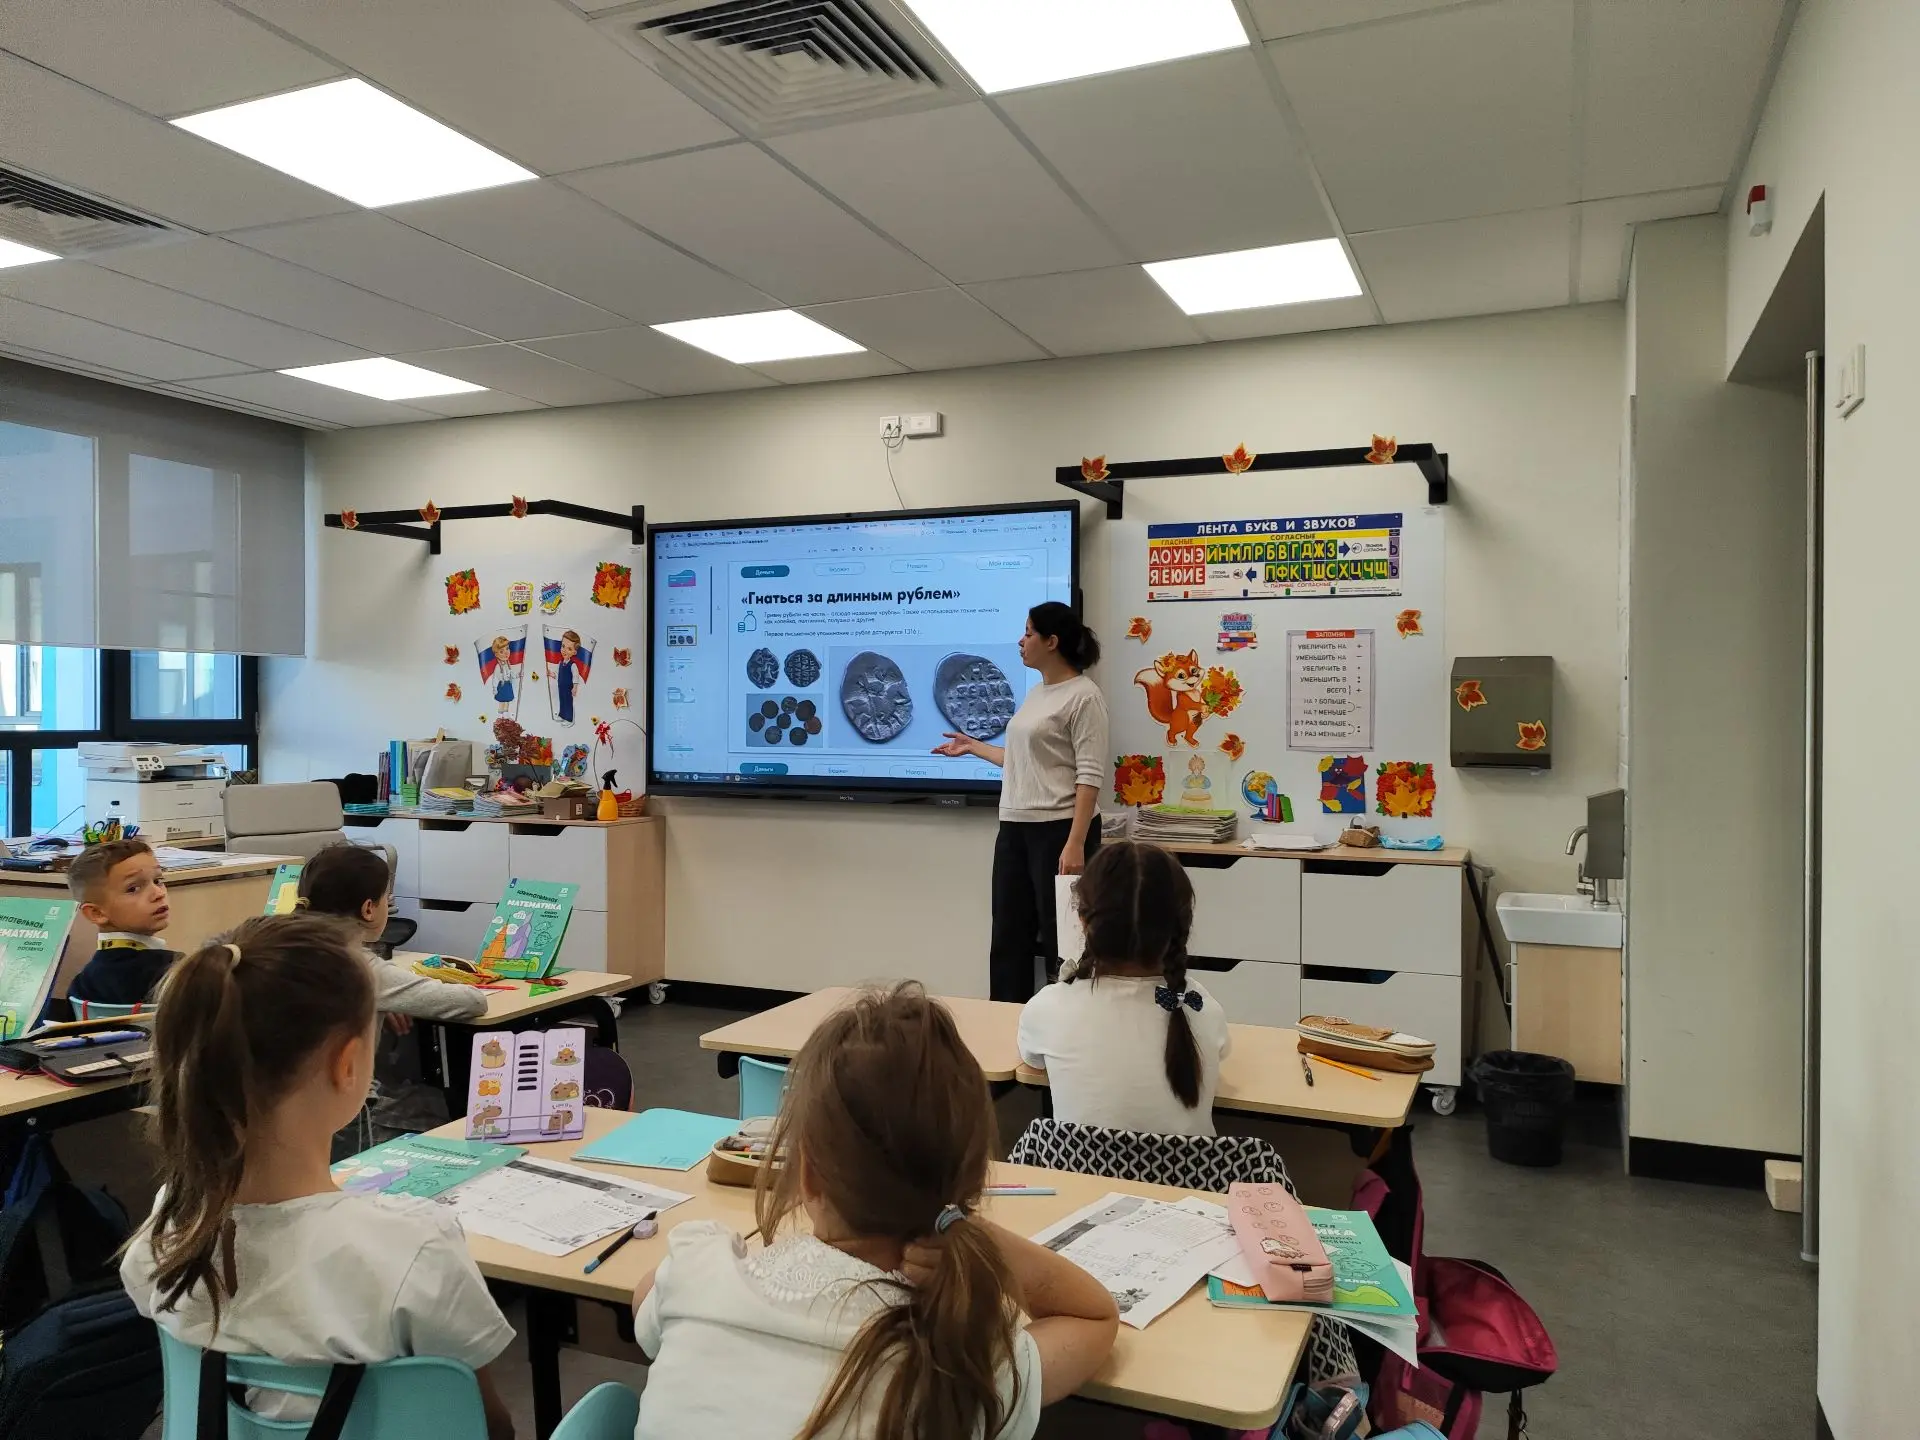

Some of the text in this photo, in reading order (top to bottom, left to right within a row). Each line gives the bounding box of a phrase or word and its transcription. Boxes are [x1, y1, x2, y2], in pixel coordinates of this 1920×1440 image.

[1197, 518, 1356, 535] ЛЕНТА БУКВ И ЗВУКОВ
[1161, 538, 1194, 546] ГЛАСНЫЕ
[1270, 533, 1316, 541] СОГЛАСНЫЕ
[741, 586, 961, 605] «Гнаться за длинным рублем»
[507, 899, 562, 910] МАТЕМАТИКА
[381, 1147, 482, 1166] МАТЕМАТИКА
